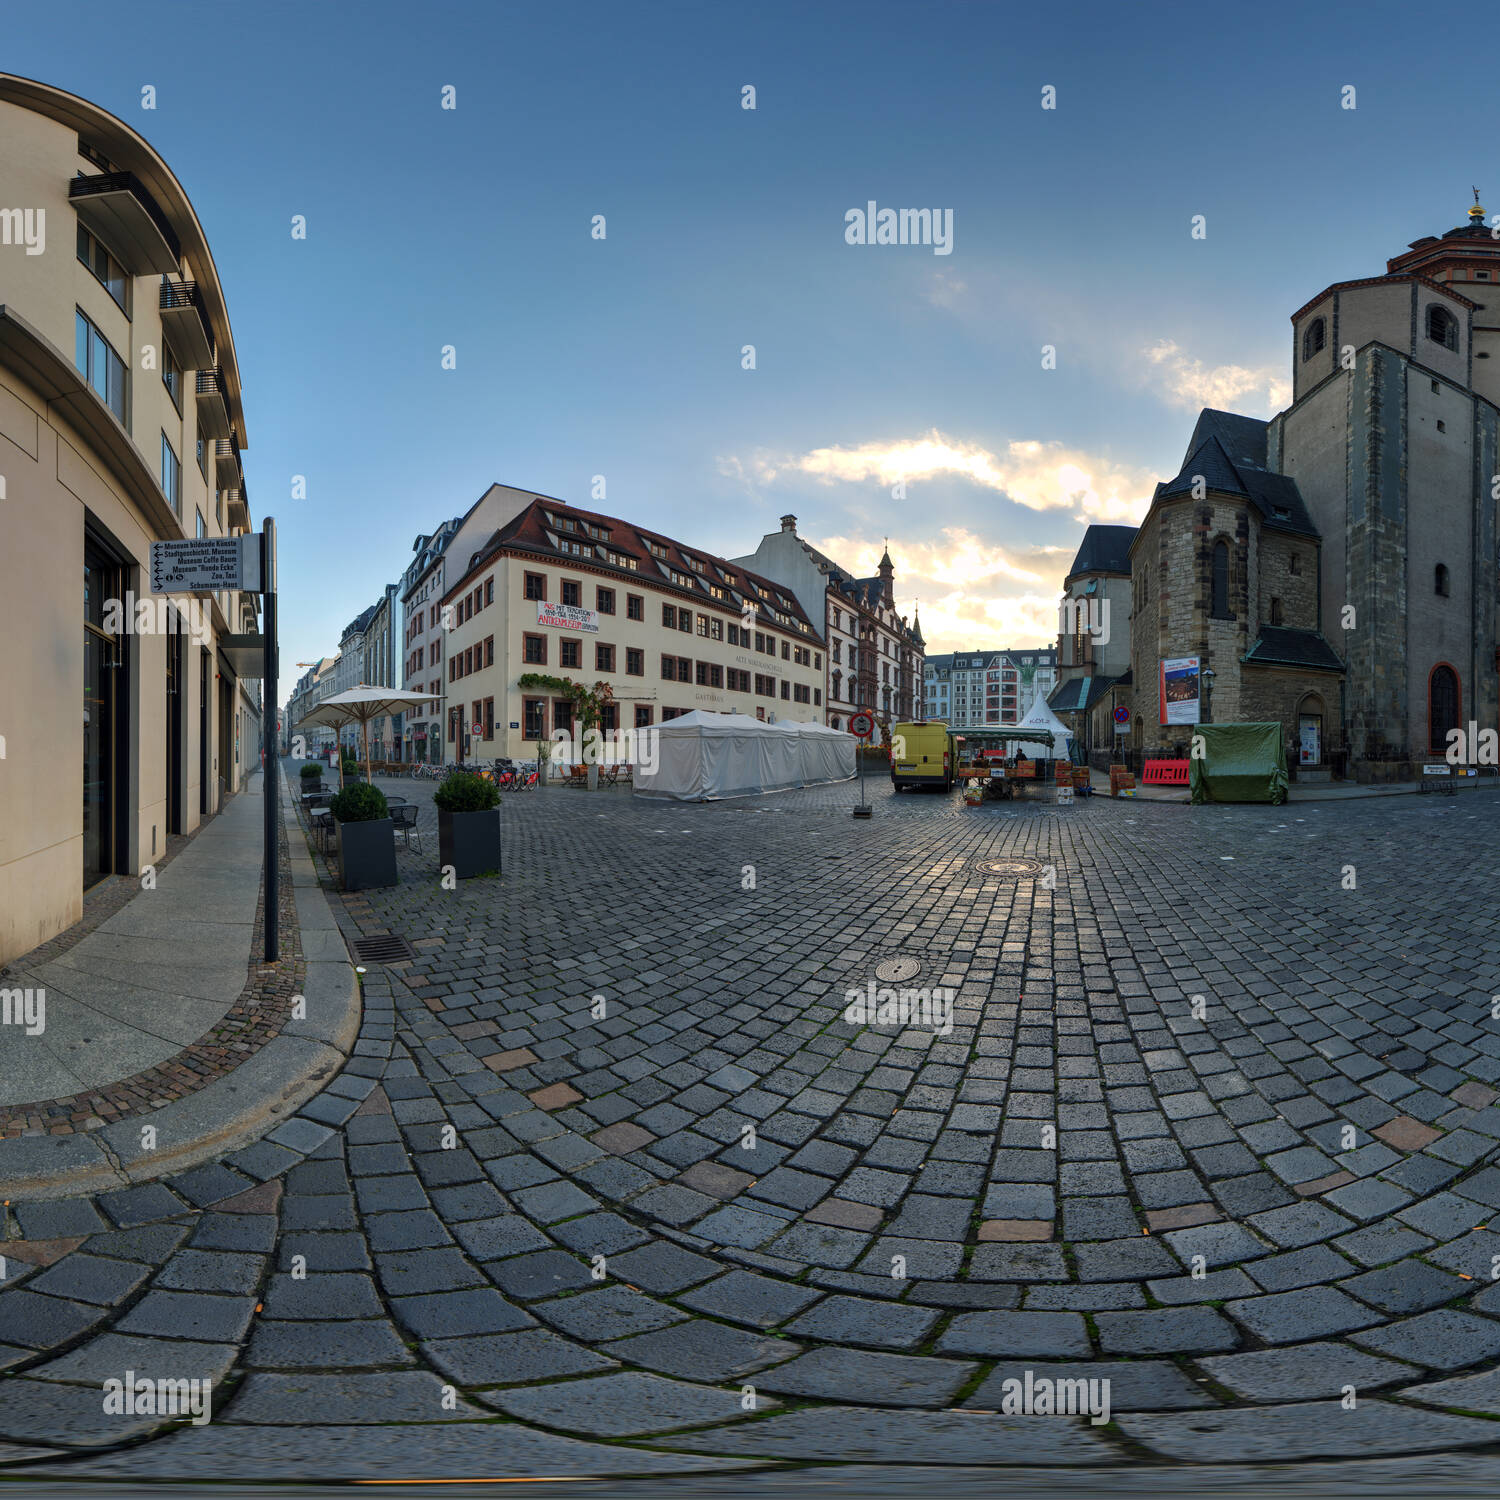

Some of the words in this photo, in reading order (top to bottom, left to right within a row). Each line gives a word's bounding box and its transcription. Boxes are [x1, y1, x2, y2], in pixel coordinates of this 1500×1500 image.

[190, 541, 215, 549] bildende
[178, 557, 202, 565] Museum
[220, 555, 237, 563] Baum
[225, 571, 237, 579] Taxi
[695, 692, 724, 703] GASTHAUS
